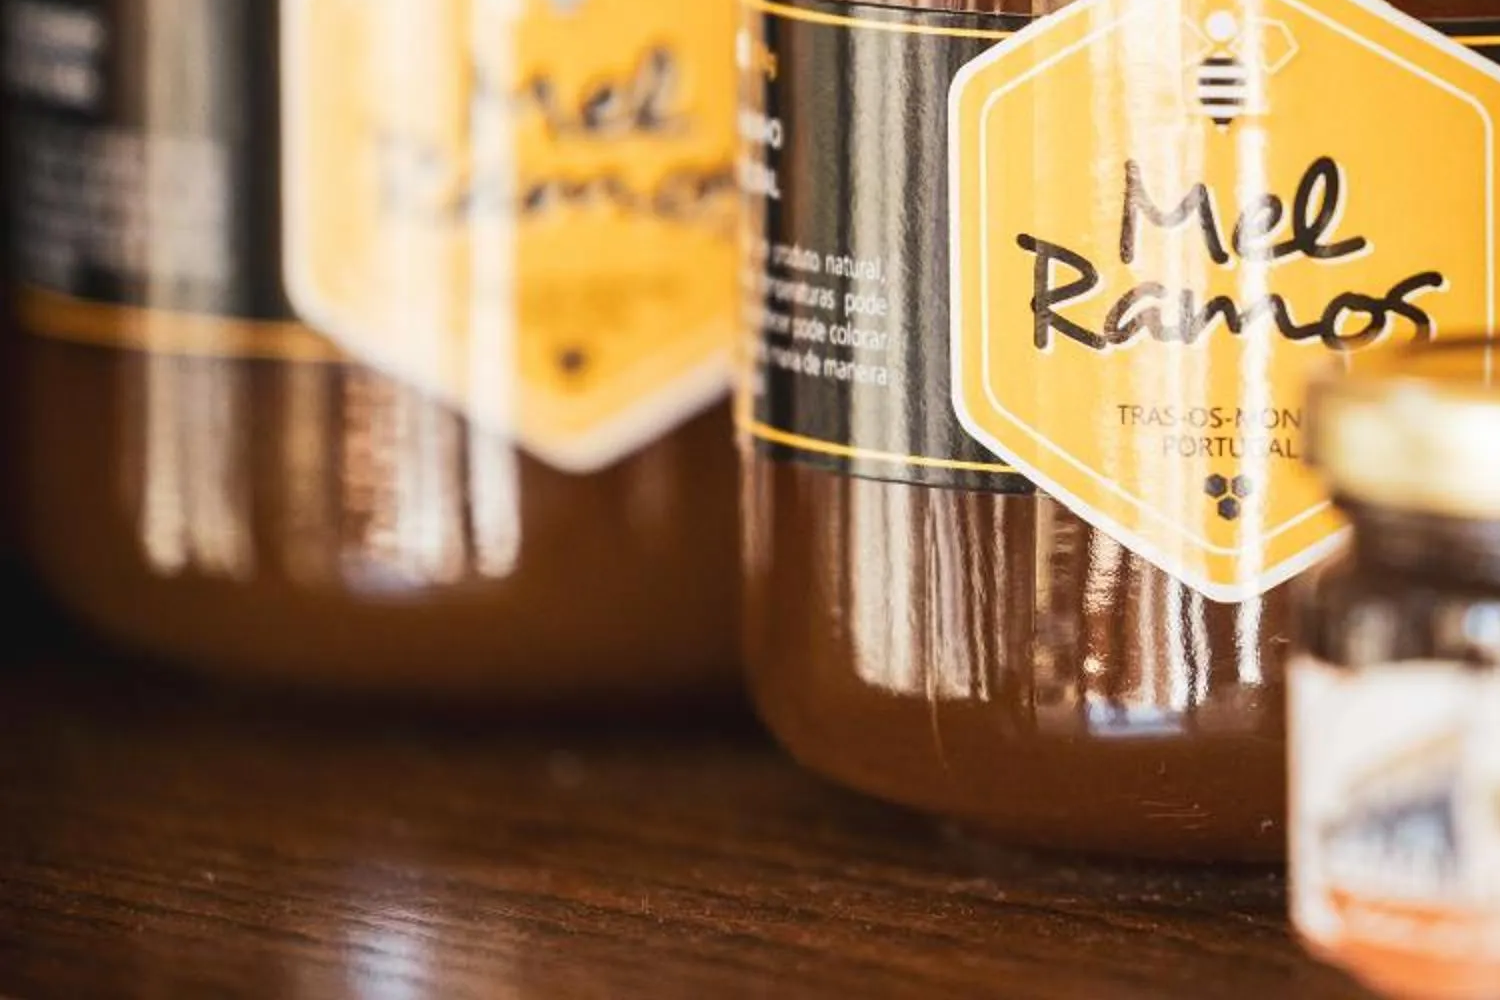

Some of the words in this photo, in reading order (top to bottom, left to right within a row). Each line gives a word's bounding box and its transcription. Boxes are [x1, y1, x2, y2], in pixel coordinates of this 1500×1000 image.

[1119, 155, 1367, 265] Mel
[844, 291, 888, 317] pode
[1016, 232, 1445, 351] Ramos
[824, 357, 887, 386] maneira
[1161, 435, 1300, 459] PORTUAL
